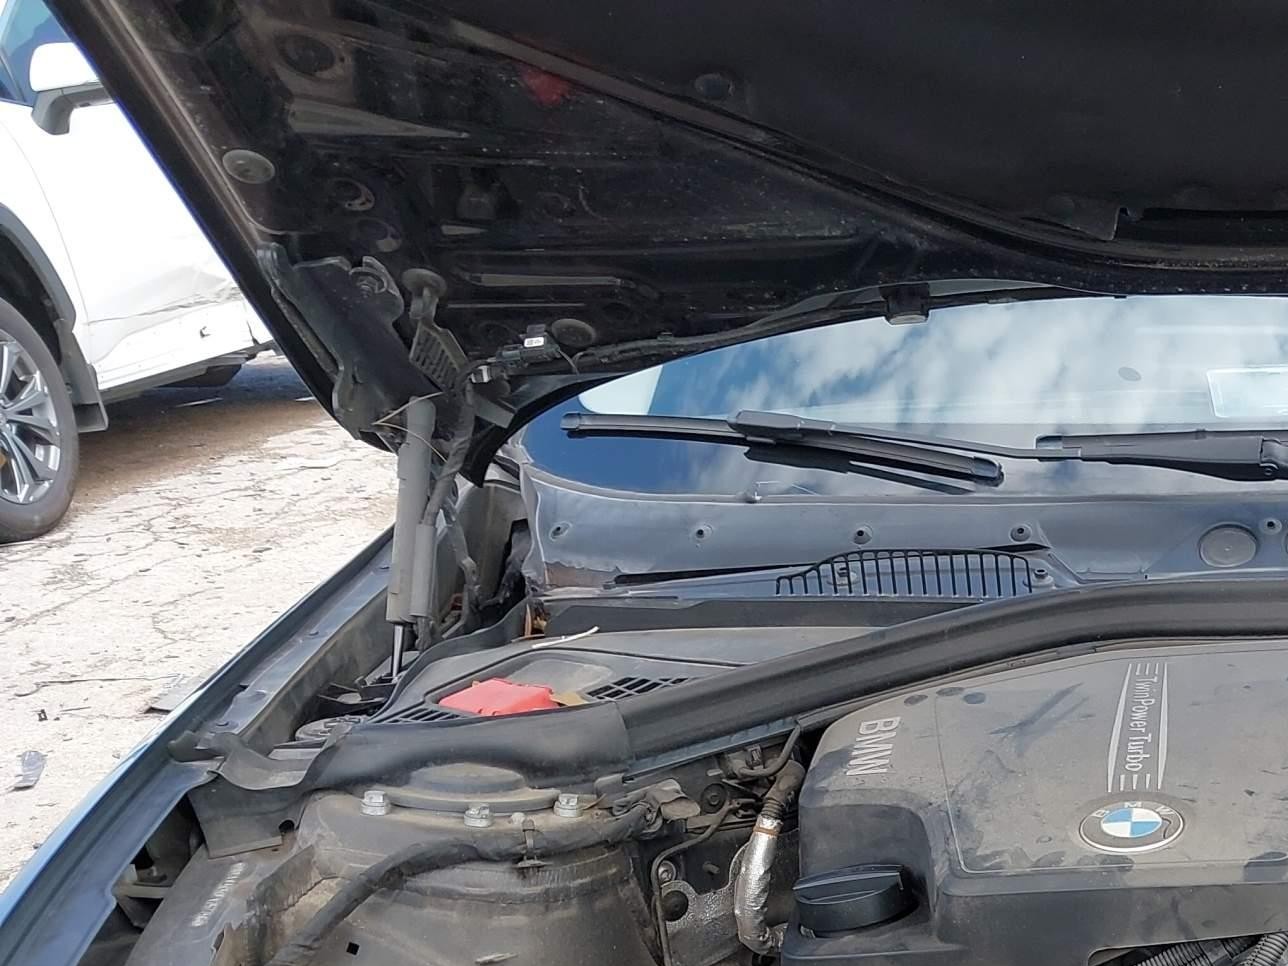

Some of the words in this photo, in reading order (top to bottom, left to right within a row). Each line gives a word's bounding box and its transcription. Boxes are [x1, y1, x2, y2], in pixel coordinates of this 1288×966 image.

[1128, 676, 1158, 733] TwinPower
[846, 717, 901, 776] BMW
[1125, 733, 1152, 772] Turbo
[1091, 801, 1175, 818] BMW
